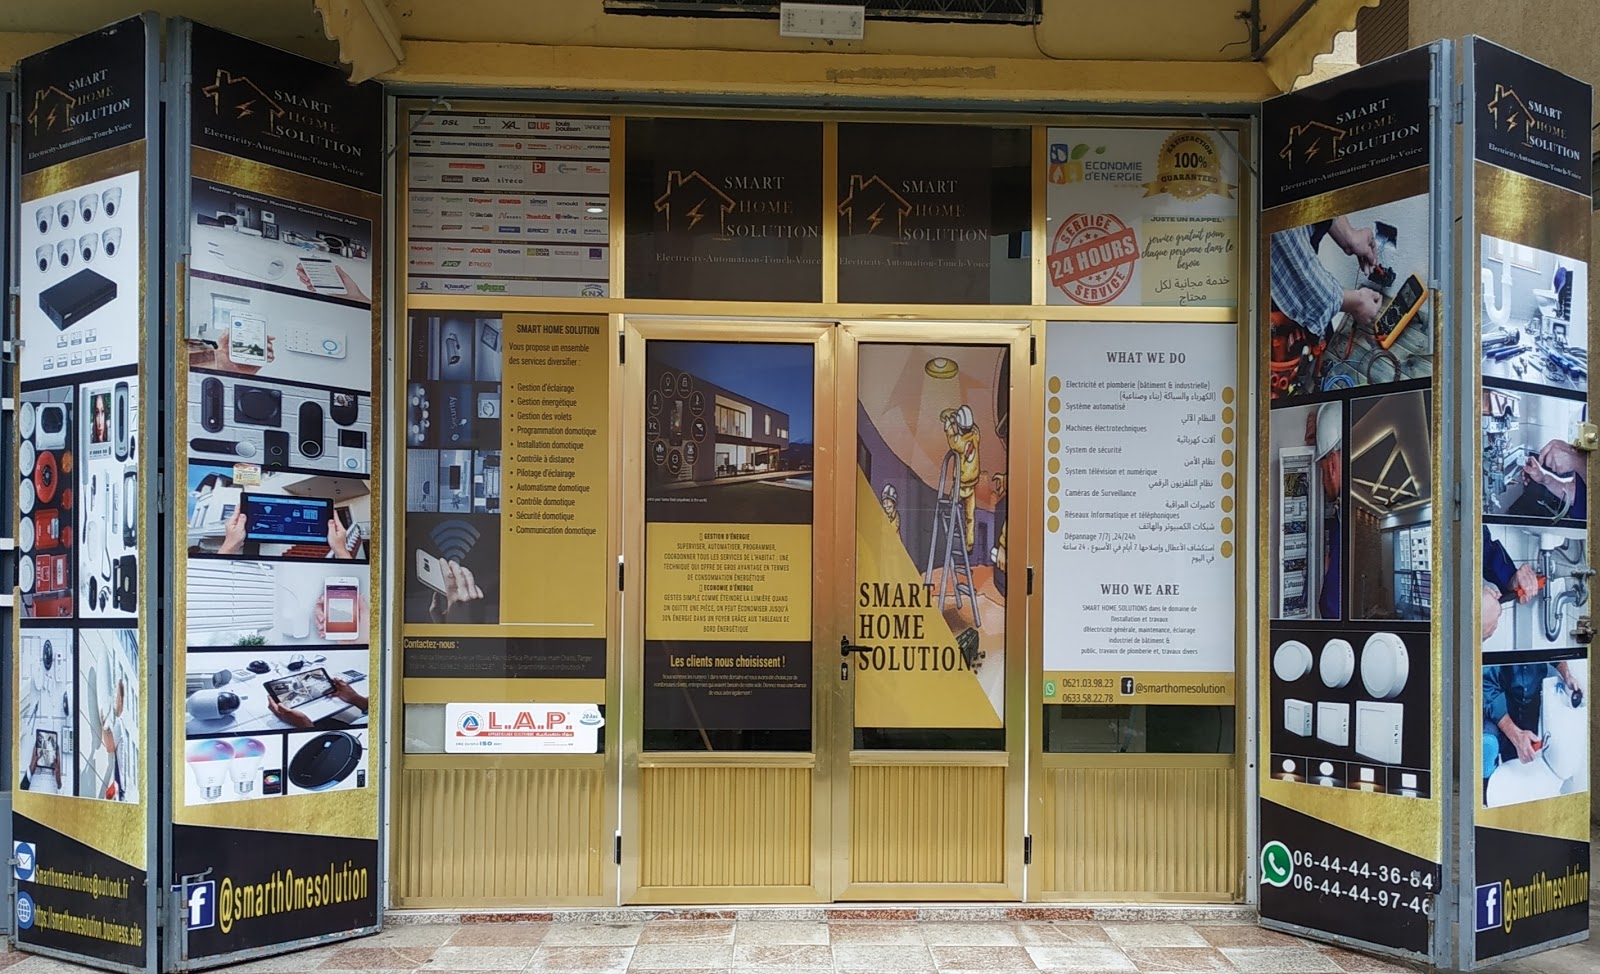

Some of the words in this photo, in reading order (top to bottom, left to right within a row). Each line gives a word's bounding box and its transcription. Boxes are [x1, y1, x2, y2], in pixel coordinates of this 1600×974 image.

[68, 69, 108, 91] SMART
[78, 86, 113, 106] HOME
[274, 90, 332, 114] SMART
[70, 98, 130, 126] SOLUTION
[1336, 98, 1389, 124] SMART
[1528, 100, 1562, 120] SMART
[288, 111, 338, 133] HOME
[536, 122, 550, 130] LUG
[1349, 114, 1396, 136] HOME
[1537, 121, 1567, 139] HOME
[276, 125, 362, 157] SOLUTION
[1166, 135, 1213, 155] SATISFACTION
[1338, 124, 1420, 157] SOLUTION
[1529, 135, 1580, 160] SOLUTION
[1085, 161, 1142, 171] ECONOMIE
[1174, 152, 1208, 169] 100%
[724, 176, 784, 189] SMART
[1085, 172, 1142, 181] d'ENERGIE
[1161, 174, 1218, 183] GUARANTEED
[902, 180, 958, 193] SMART
[209, 185, 230, 194] Home
[233, 190, 267, 204] Appliance
[270, 200, 296, 211] Remote
[298, 206, 322, 216] Control
[324, 213, 343, 222] Using
[344, 218, 357, 226] App
[740, 201, 793, 214] HOME
[916, 205, 965, 217] HOME
[727, 225, 818, 238] SOLUTION
[903, 228, 988, 241] SOLUTION
[1061, 215, 1111, 244] SERVICE
[1149, 234, 1174, 245] service
[1175, 228, 1204, 246] gratuit
[1205, 231, 1225, 244] pour
[1141, 245, 1168, 260] chaque
[1169, 247, 1203, 260] personne
[1225, 239, 1234, 252] le
[1051, 260, 1074, 280] 24
[1076, 237, 1135, 271] HOURS
[1177, 257, 1200, 269] besoin
[1075, 271, 1125, 300] SERVICE
[1155, 279, 1172, 293] لكل
[1175, 278, 1203, 290] مجانية
[1206, 276, 1230, 286] خدمة
[1179, 293, 1207, 306] محتاج
[517, 324, 541, 333] SMART
[543, 325, 563, 334] HOME
[565, 326, 599, 334] SOLUTION
[509, 342, 524, 351] Vous
[560, 344, 589, 352] ensemble
[1107, 352, 1143, 363] WHAT
[1147, 352, 1165, 363] WE
[1170, 352, 1186, 364] DO
[517, 383, 540, 391] Gestion
[542, 384, 575, 394] d'éclairage
[1106, 381, 1135, 389] plomberie
[1138, 380, 1166, 389] (bâtiment
[1174, 381, 1210, 390] industrielle)
[517, 397, 540, 406] Gestion
[542, 397, 577, 408] énergétique
[1066, 402, 1091, 410] Système
[517, 412, 540, 420] Gestion
[542, 412, 552, 420] des
[554, 412, 572, 420] volets
[517, 426, 563, 436] Programmation
[565, 427, 596, 437] domotique
[1066, 424, 1092, 432] Machines
[1095, 425, 1147, 434] électrotechniques
[517, 440, 550, 449] Installation
[552, 441, 584, 451] domotique
[1065, 446, 1087, 454] System
[1089, 446, 1096, 454] de
[1098, 446, 1122, 454] sécurité
[517, 455, 542, 463] Contrôle
[544, 455, 547, 463] à
[517, 469, 541, 479] Pilotage
[543, 469, 575, 479] d'éclairage
[516, 483, 556, 491] Automatisme
[558, 484, 590, 493] domotique
[1065, 489, 1090, 497] Caméras
[1101, 489, 1136, 497] Surveillance
[516, 497, 542, 506] Contrôle
[543, 498, 575, 507] domotique
[516, 511, 541, 520] Sécurité
[542, 512, 574, 521] domotique
[516, 526, 563, 534] Communication
[564, 527, 596, 536] domotique
[859, 582, 935, 608] SMART
[1100, 584, 1129, 595] WHO
[1134, 584, 1152, 595] WE
[1156, 584, 1180, 595] ARE
[859, 614, 925, 639] HOME
[404, 639, 455, 649] Contactez-nous
[670, 655, 684, 667] Les
[686, 655, 713, 668] clients
[715, 658, 734, 668] nous
[736, 655, 781, 668] choisissent
[859, 646, 971, 671] SOLUTION
[1063, 679, 1113, 688] 0621.03.98.23
[1136, 683, 1225, 694] @smarthomesolution
[1063, 694, 1113, 702] 0633.58.22.78
[488, 711, 573, 730] L.A.P.
[1294, 850, 1433, 890] 06-44-44-36-84
[220, 859, 367, 934] @smarth0mesolution
[1294, 874, 1430, 915] 06-44-44-97-46
[1504, 863, 1588, 933] @smarth0mesolution
